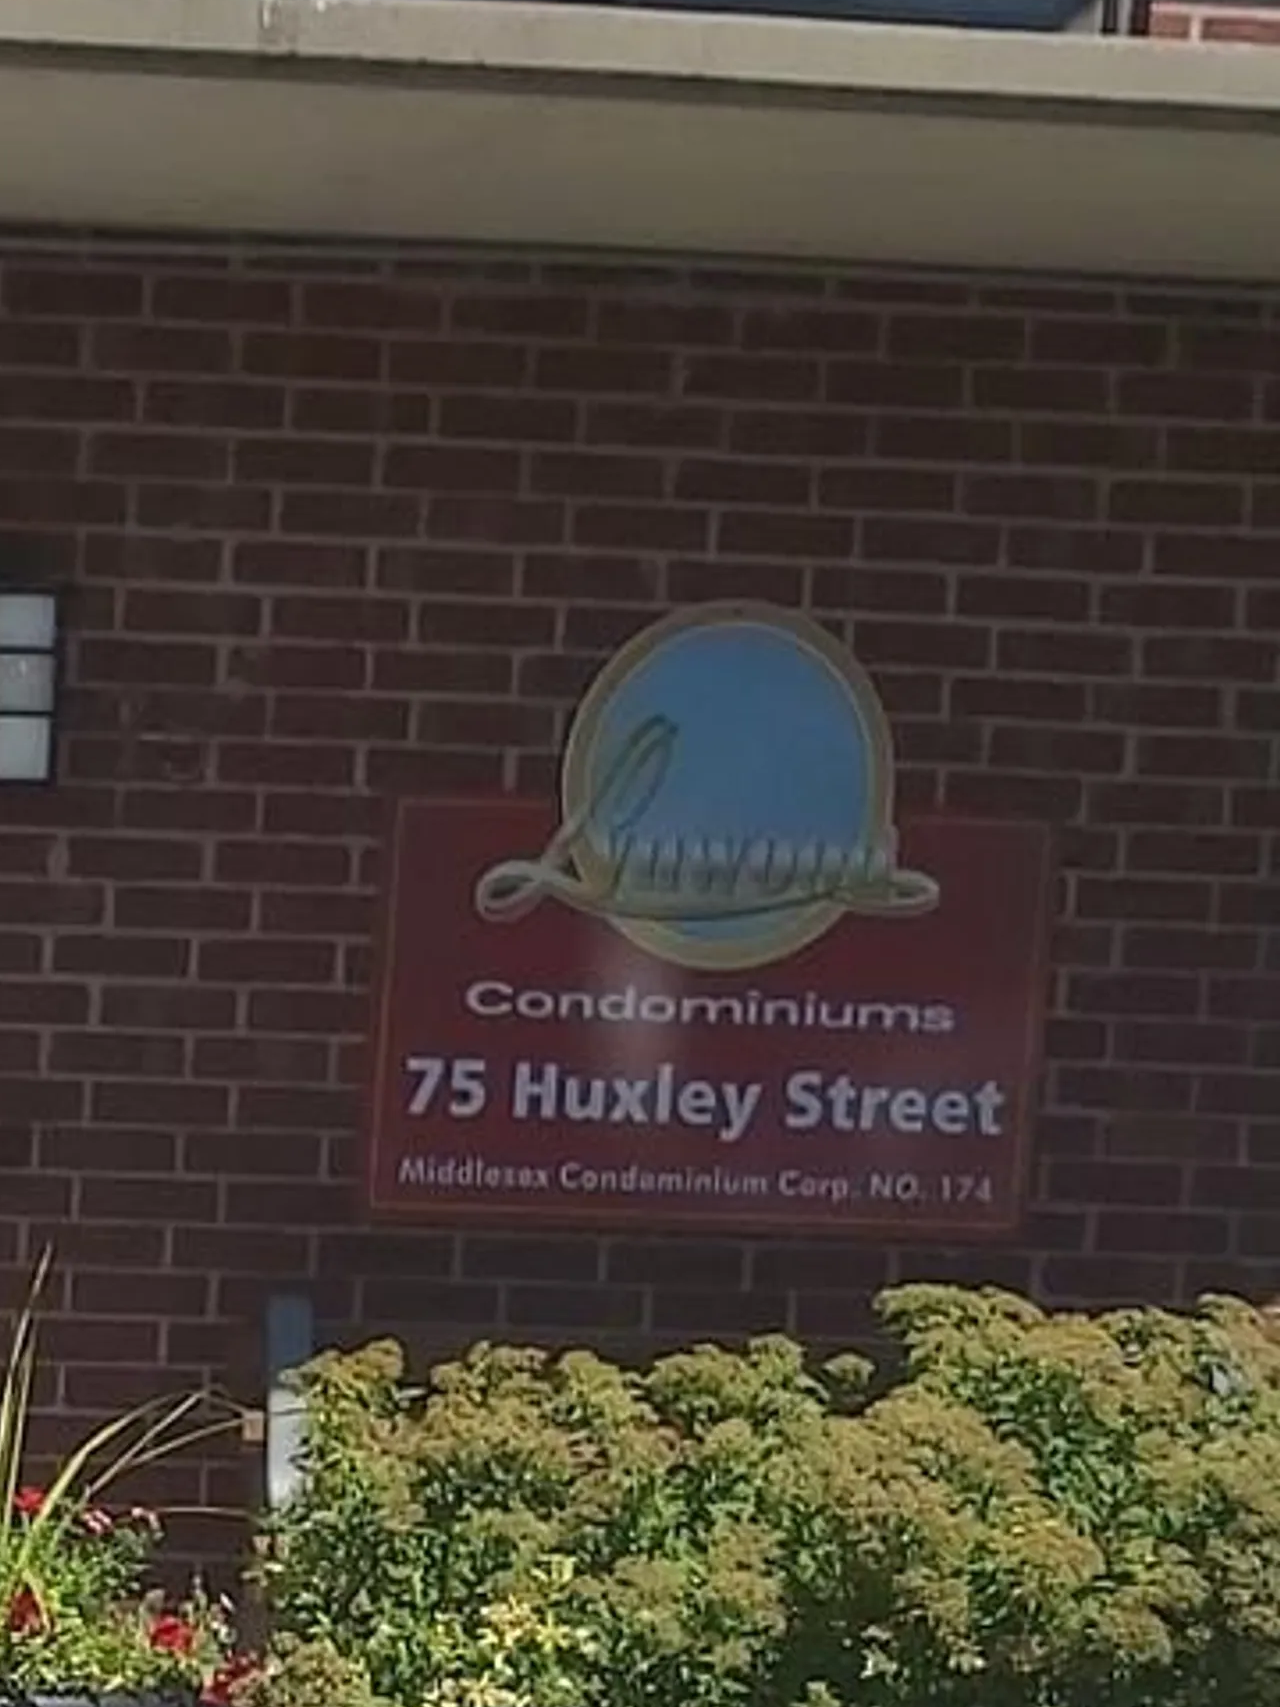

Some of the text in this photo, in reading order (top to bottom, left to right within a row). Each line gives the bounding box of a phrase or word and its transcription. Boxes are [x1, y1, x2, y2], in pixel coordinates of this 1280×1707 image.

[464, 979, 955, 1034] Condominiums
[404, 1056, 1005, 1141] 75 Huxley Street
[397, 1153, 549, 1190] Middlesex
[558, 1159, 770, 1196] Condominium
[941, 1174, 992, 1204] 174
